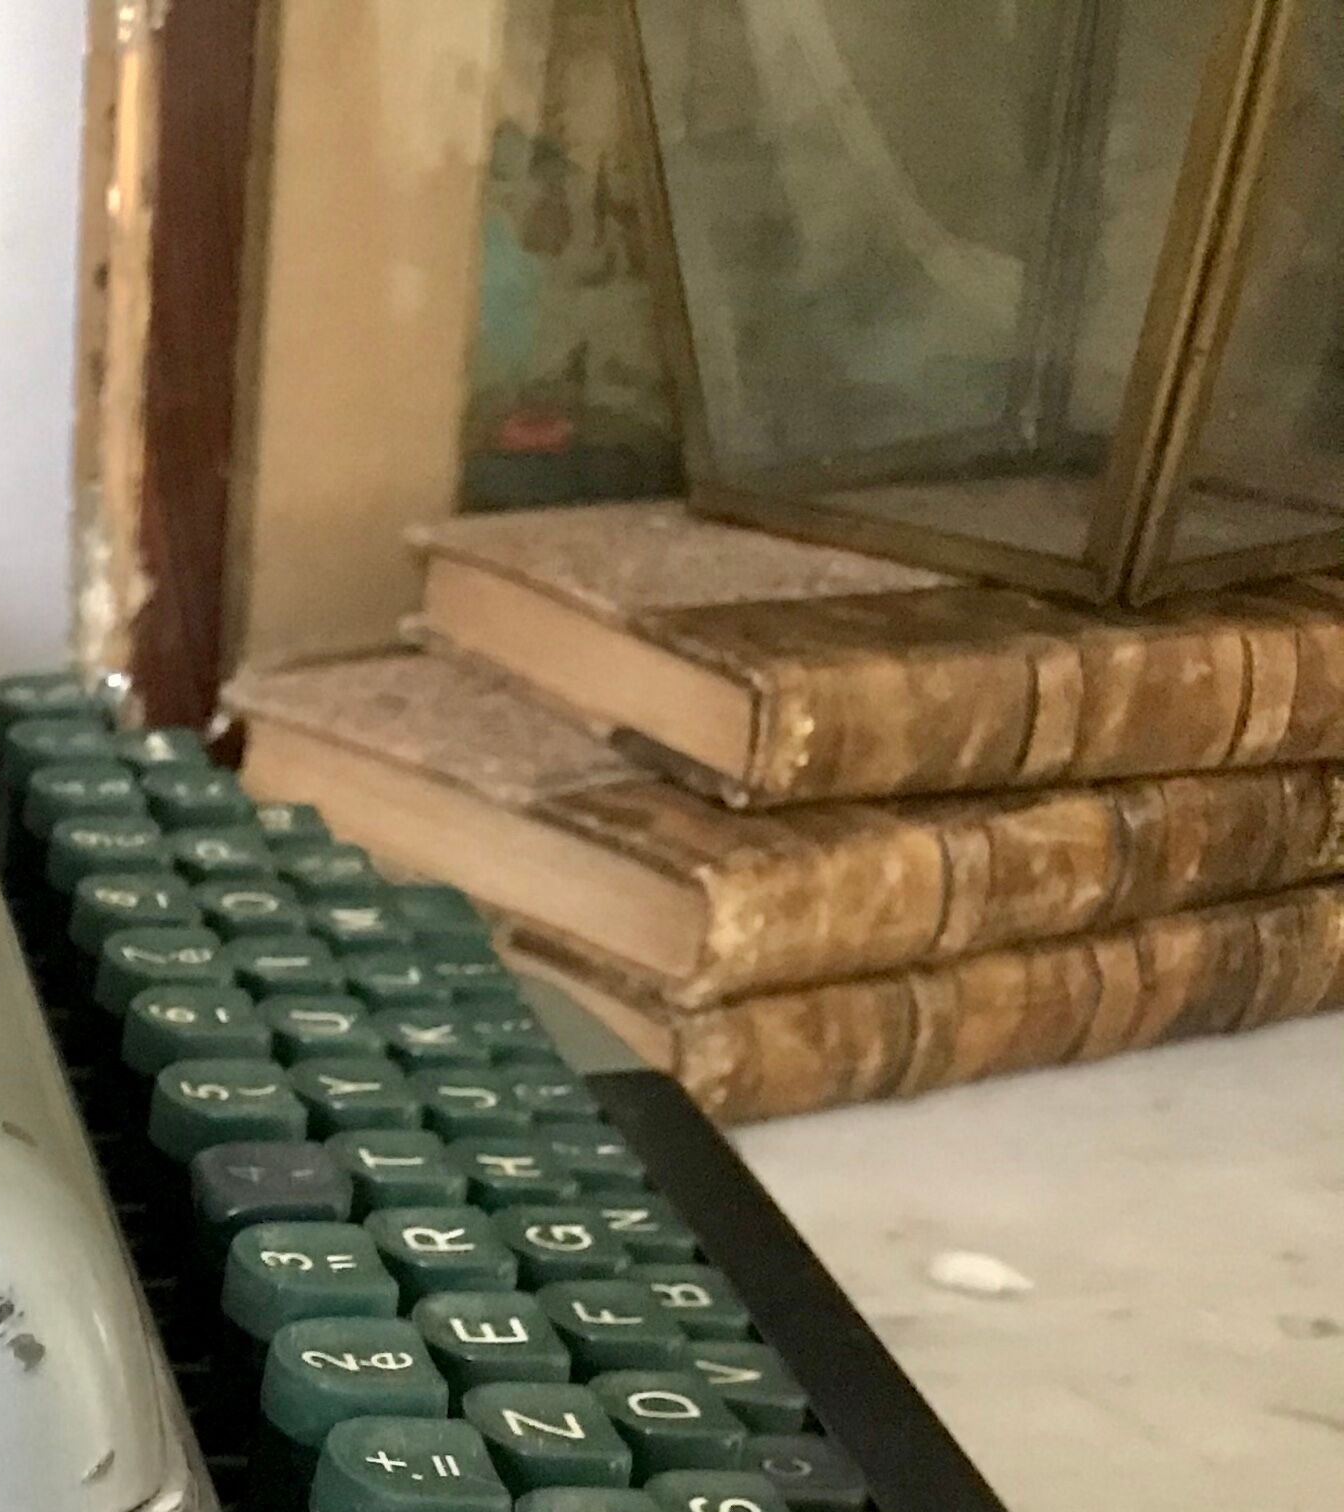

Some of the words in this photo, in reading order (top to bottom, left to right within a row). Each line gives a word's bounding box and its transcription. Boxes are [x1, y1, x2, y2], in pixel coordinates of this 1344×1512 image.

[222, 893, 278, 912] O
[370, 967, 421, 985] L
[400, 1025, 455, 1044] K
[181, 1082, 229, 1100] 5
[320, 1077, 380, 1094] Y
[439, 1086, 498, 1108] J
[359, 1149, 422, 1167] T
[476, 1155, 541, 1177] H
[228, 1165, 264, 1182] 4
[601, 1208, 659, 1231] N
[403, 1227, 475, 1252] R
[526, 1226, 592, 1250] G
[261, 1252, 312, 1270] 3
[651, 1283, 713, 1307] B
[573, 1302, 641, 1323] F
[451, 1318, 528, 1343] E
[302, 1350, 359, 1371] 2
[696, 1361, 760, 1383] V
[628, 1392, 700, 1417] D
[503, 1410, 584, 1438] Z
[762, 1460, 812, 1477] C
